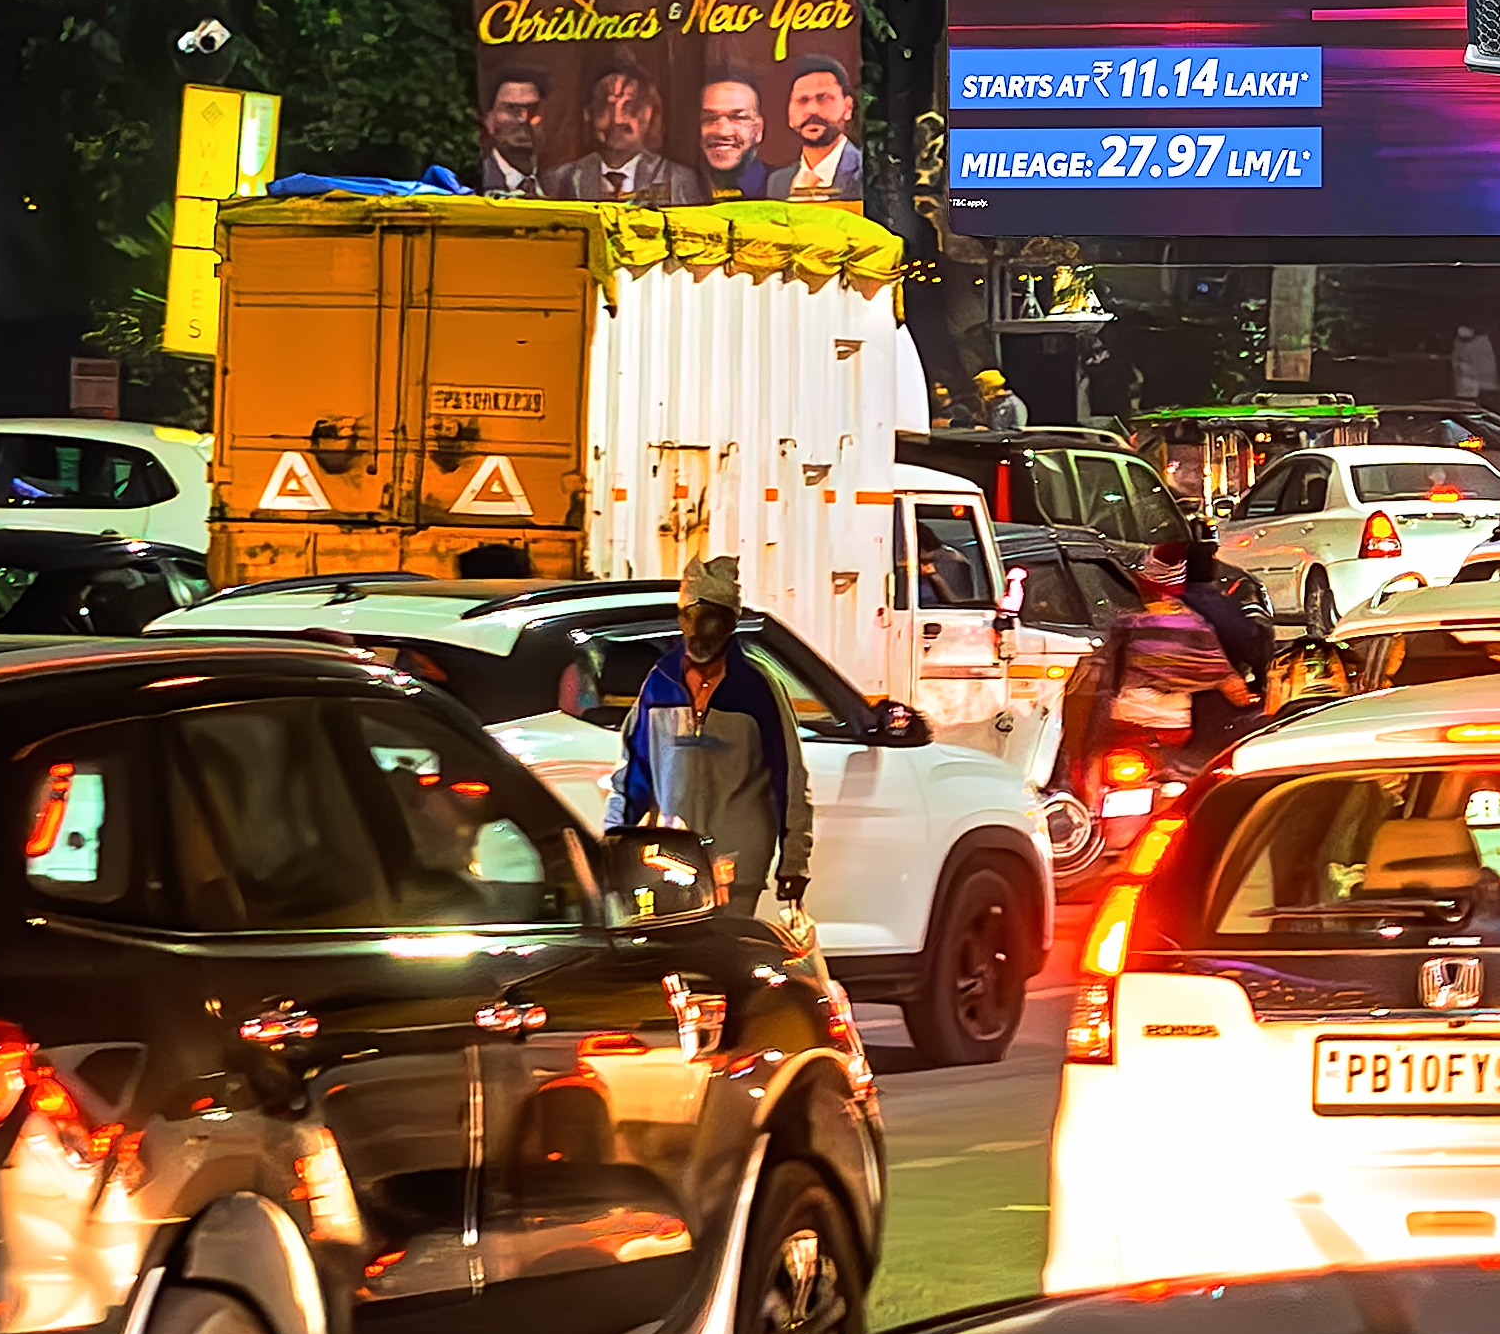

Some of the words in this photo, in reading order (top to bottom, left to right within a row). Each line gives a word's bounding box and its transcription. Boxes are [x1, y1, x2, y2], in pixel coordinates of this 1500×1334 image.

[962, 76, 1052, 98] STARTS
[1055, 76, 1089, 98] AT
[960, 153, 1094, 178] MILEAGE:
[1097, 134, 1226, 179] 27.97
